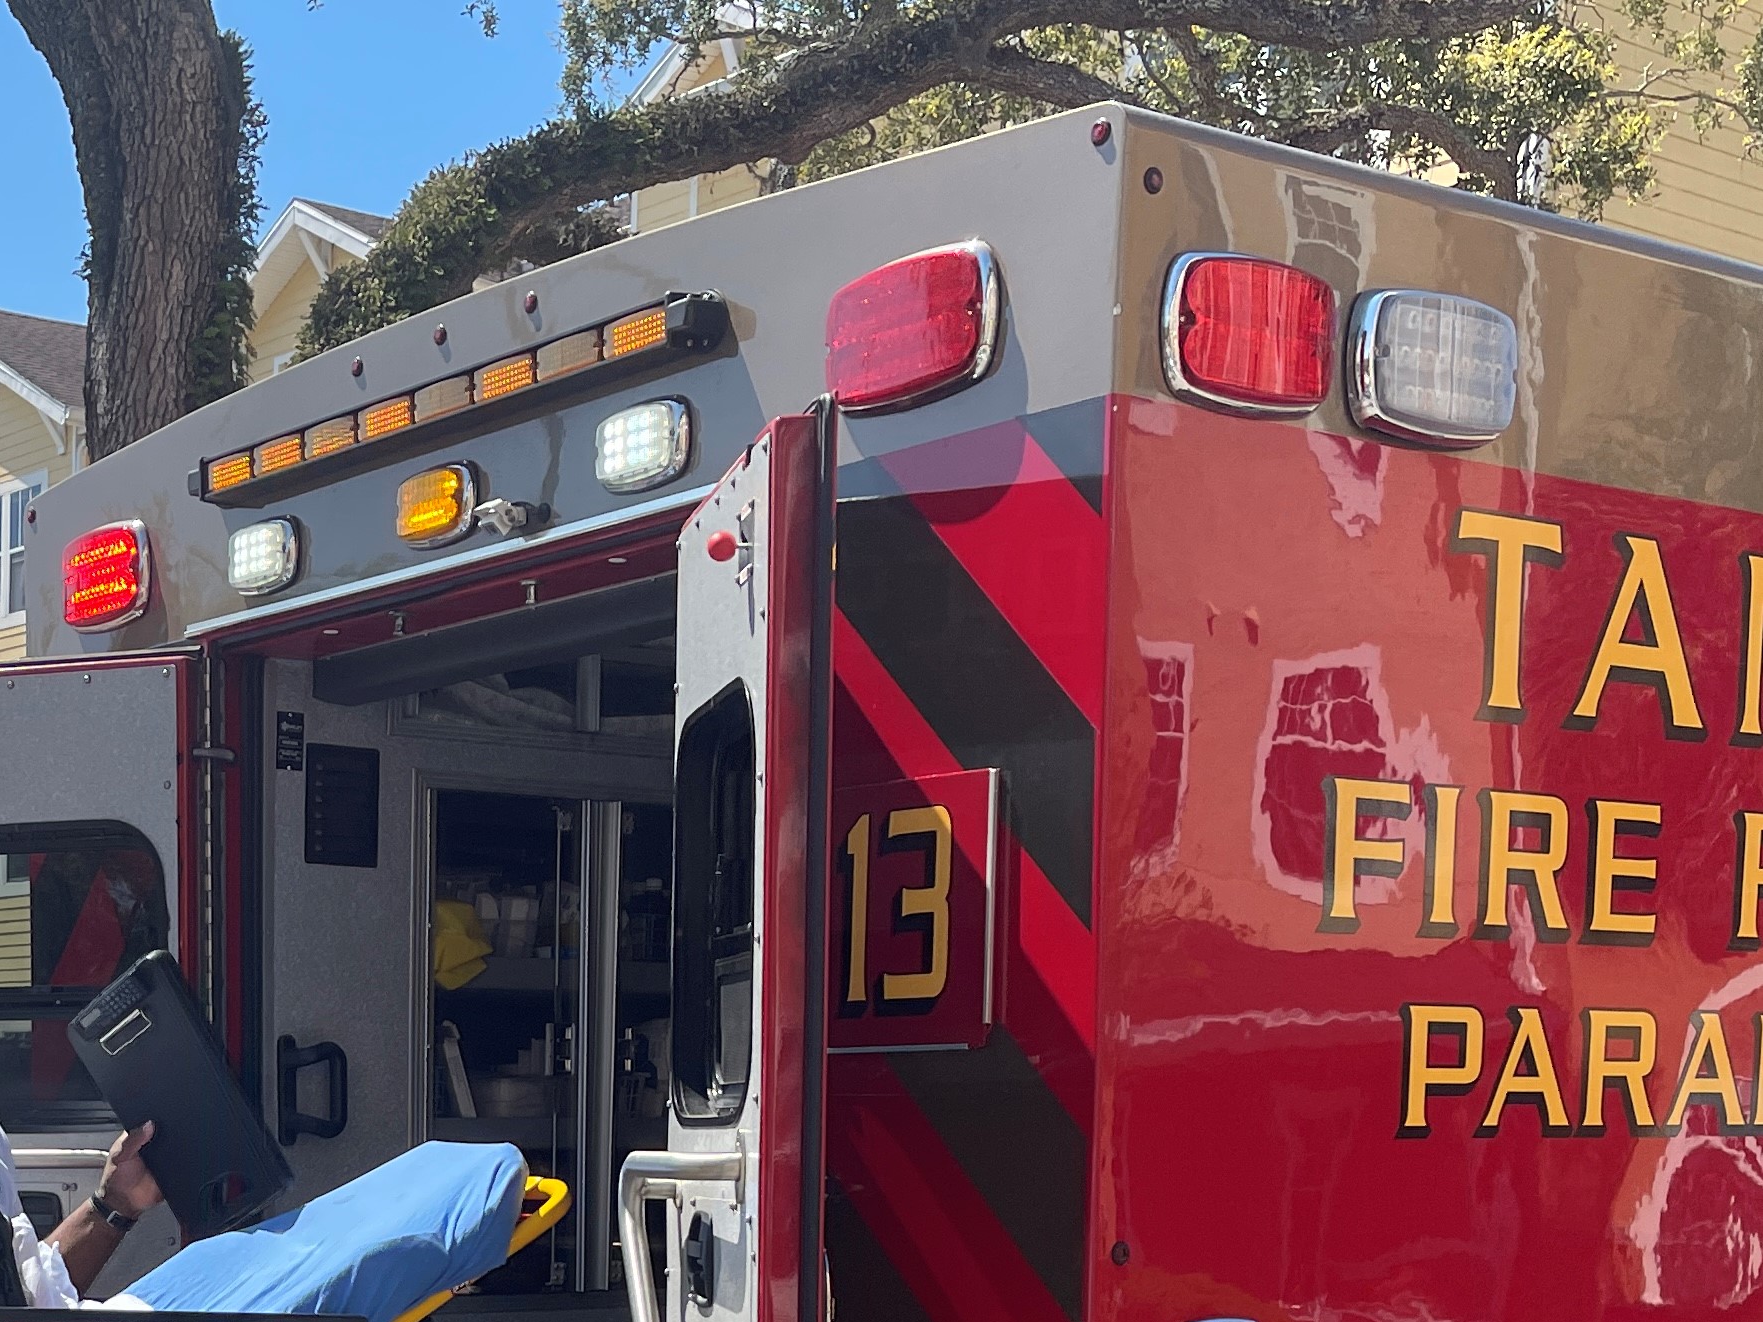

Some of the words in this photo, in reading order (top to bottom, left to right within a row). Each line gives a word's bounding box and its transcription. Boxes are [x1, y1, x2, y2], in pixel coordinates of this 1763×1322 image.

[842, 803, 953, 1012] 13
[1325, 776, 1664, 936] FIRE
[1401, 1003, 1763, 1131] PARA
